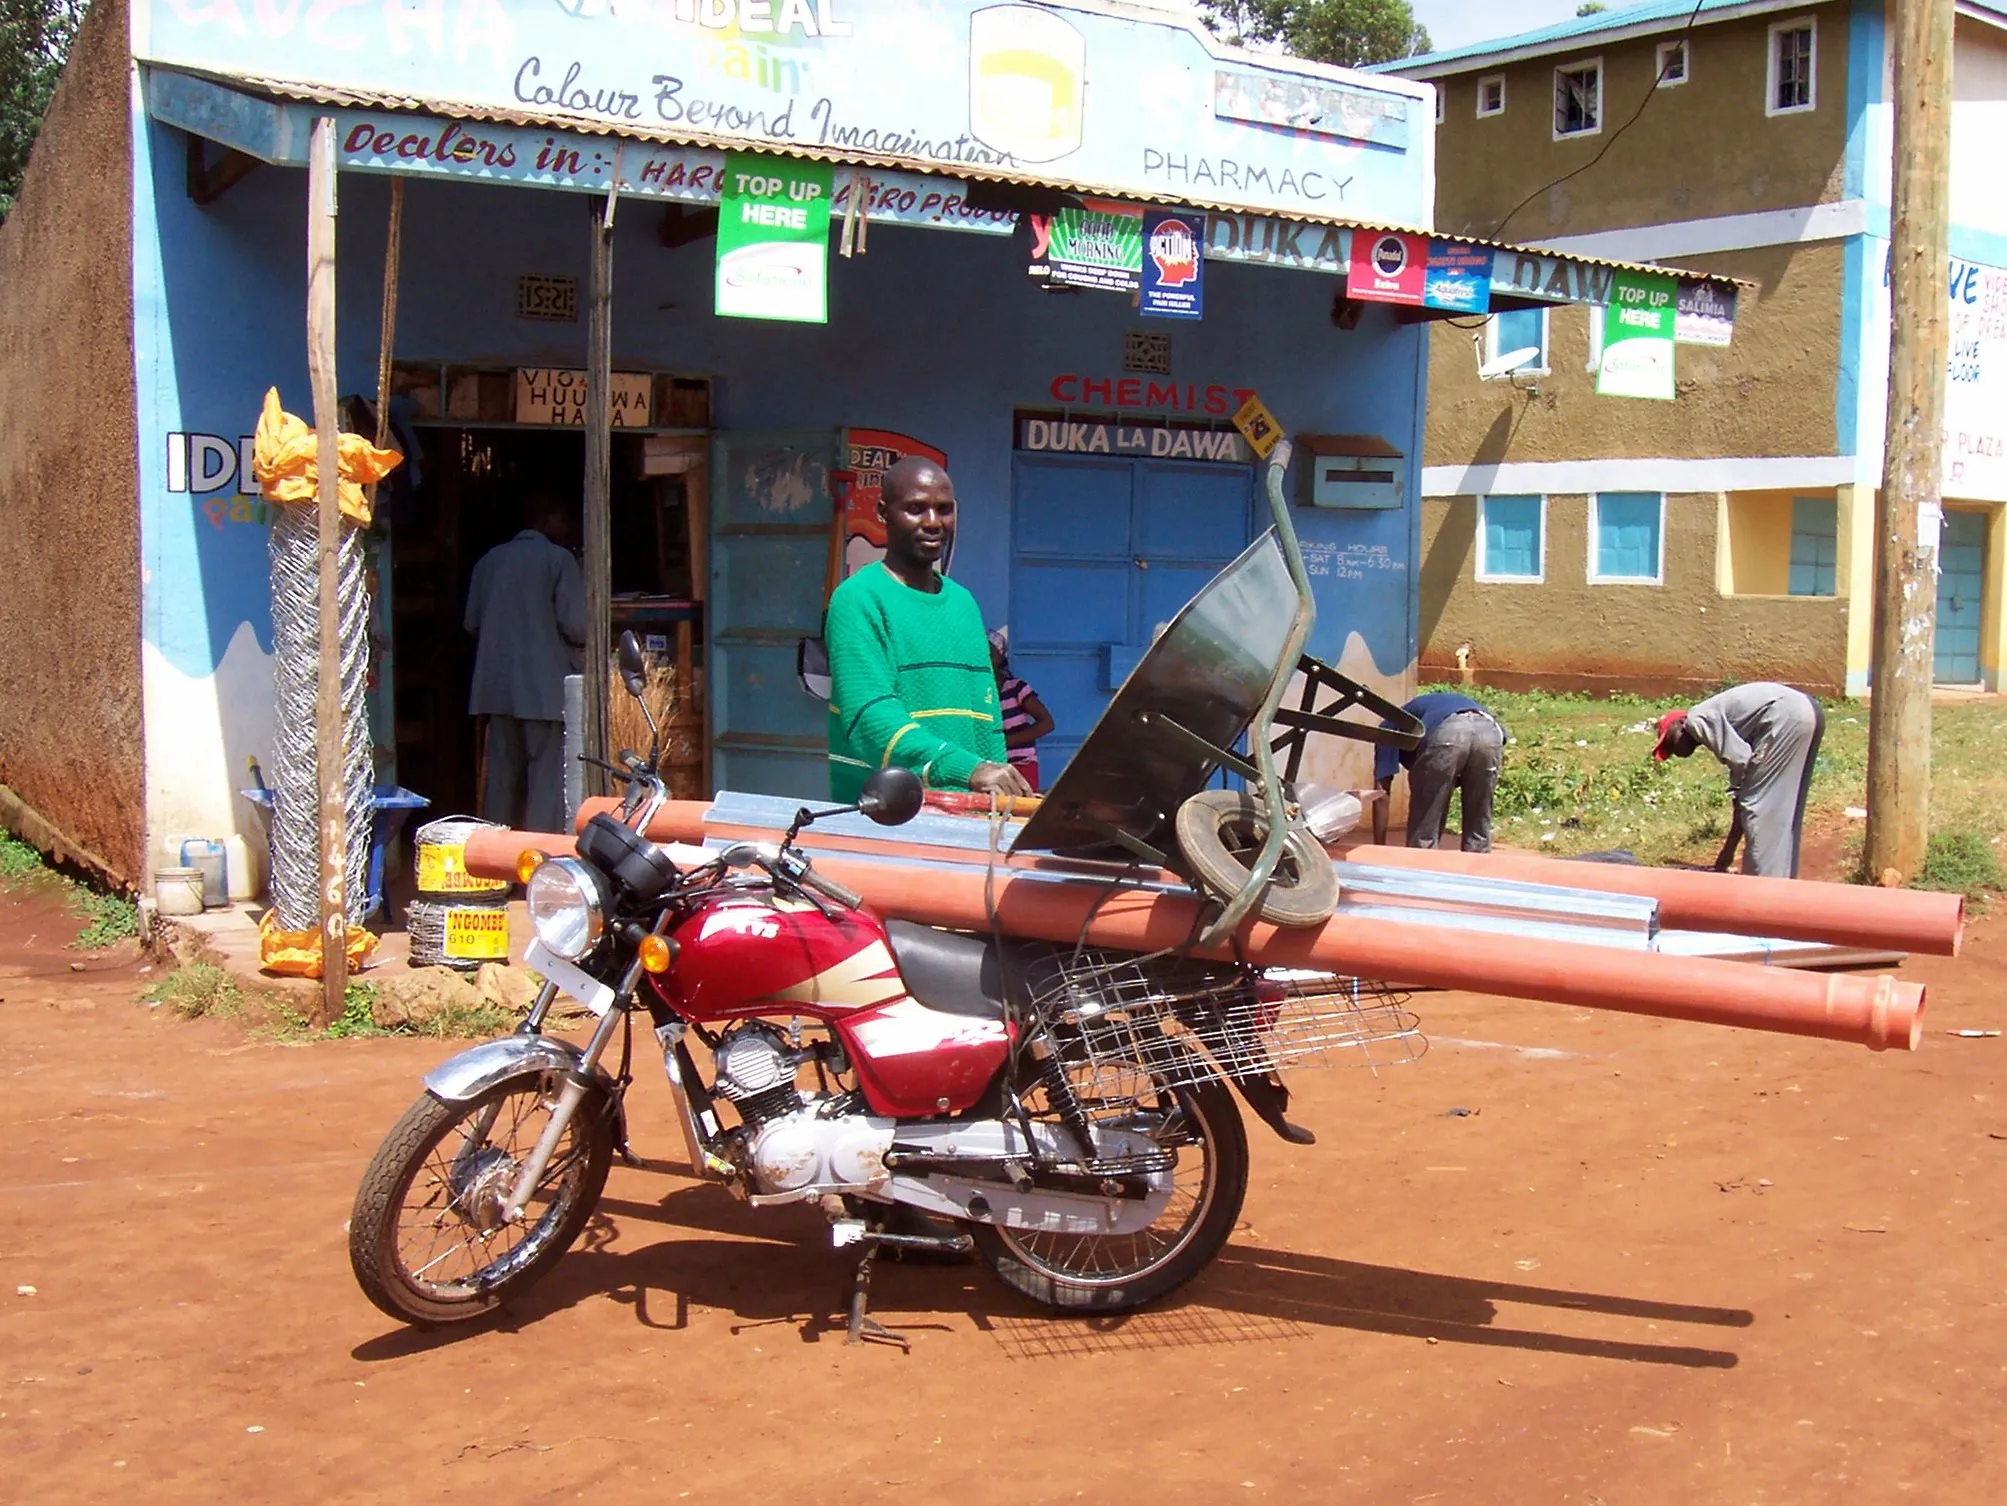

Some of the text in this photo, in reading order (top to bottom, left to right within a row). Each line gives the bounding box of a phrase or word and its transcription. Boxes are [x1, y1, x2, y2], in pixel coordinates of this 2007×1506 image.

[514, 56, 1020, 169] Colour Beyond Imagination
[344, 121, 516, 168] Dealers
[1143, 147, 1353, 201] PHARMACY
[736, 174, 821, 201] TOP UP
[741, 203, 808, 230] HERE
[1068, 239, 1125, 260] MORNING
[1206, 214, 1345, 267] DUKA
[1618, 286, 1669, 307] TOP UP
[1678, 298, 1725, 316] SALIMIA
[1619, 308, 1661, 329] HERE
[1955, 340, 1979, 359] LIVE
[530, 387, 647, 410] HUUWA
[1050, 374, 1256, 415] CHEMIST
[552, 406, 624, 426] HAA
[1027, 419, 1110, 453] DUKA
[1116, 428, 1146, 448] LA
[1151, 428, 1238, 461] DAWA
[1958, 432, 2003, 457] PLAZA
[1308, 564, 1329, 575] SUN
